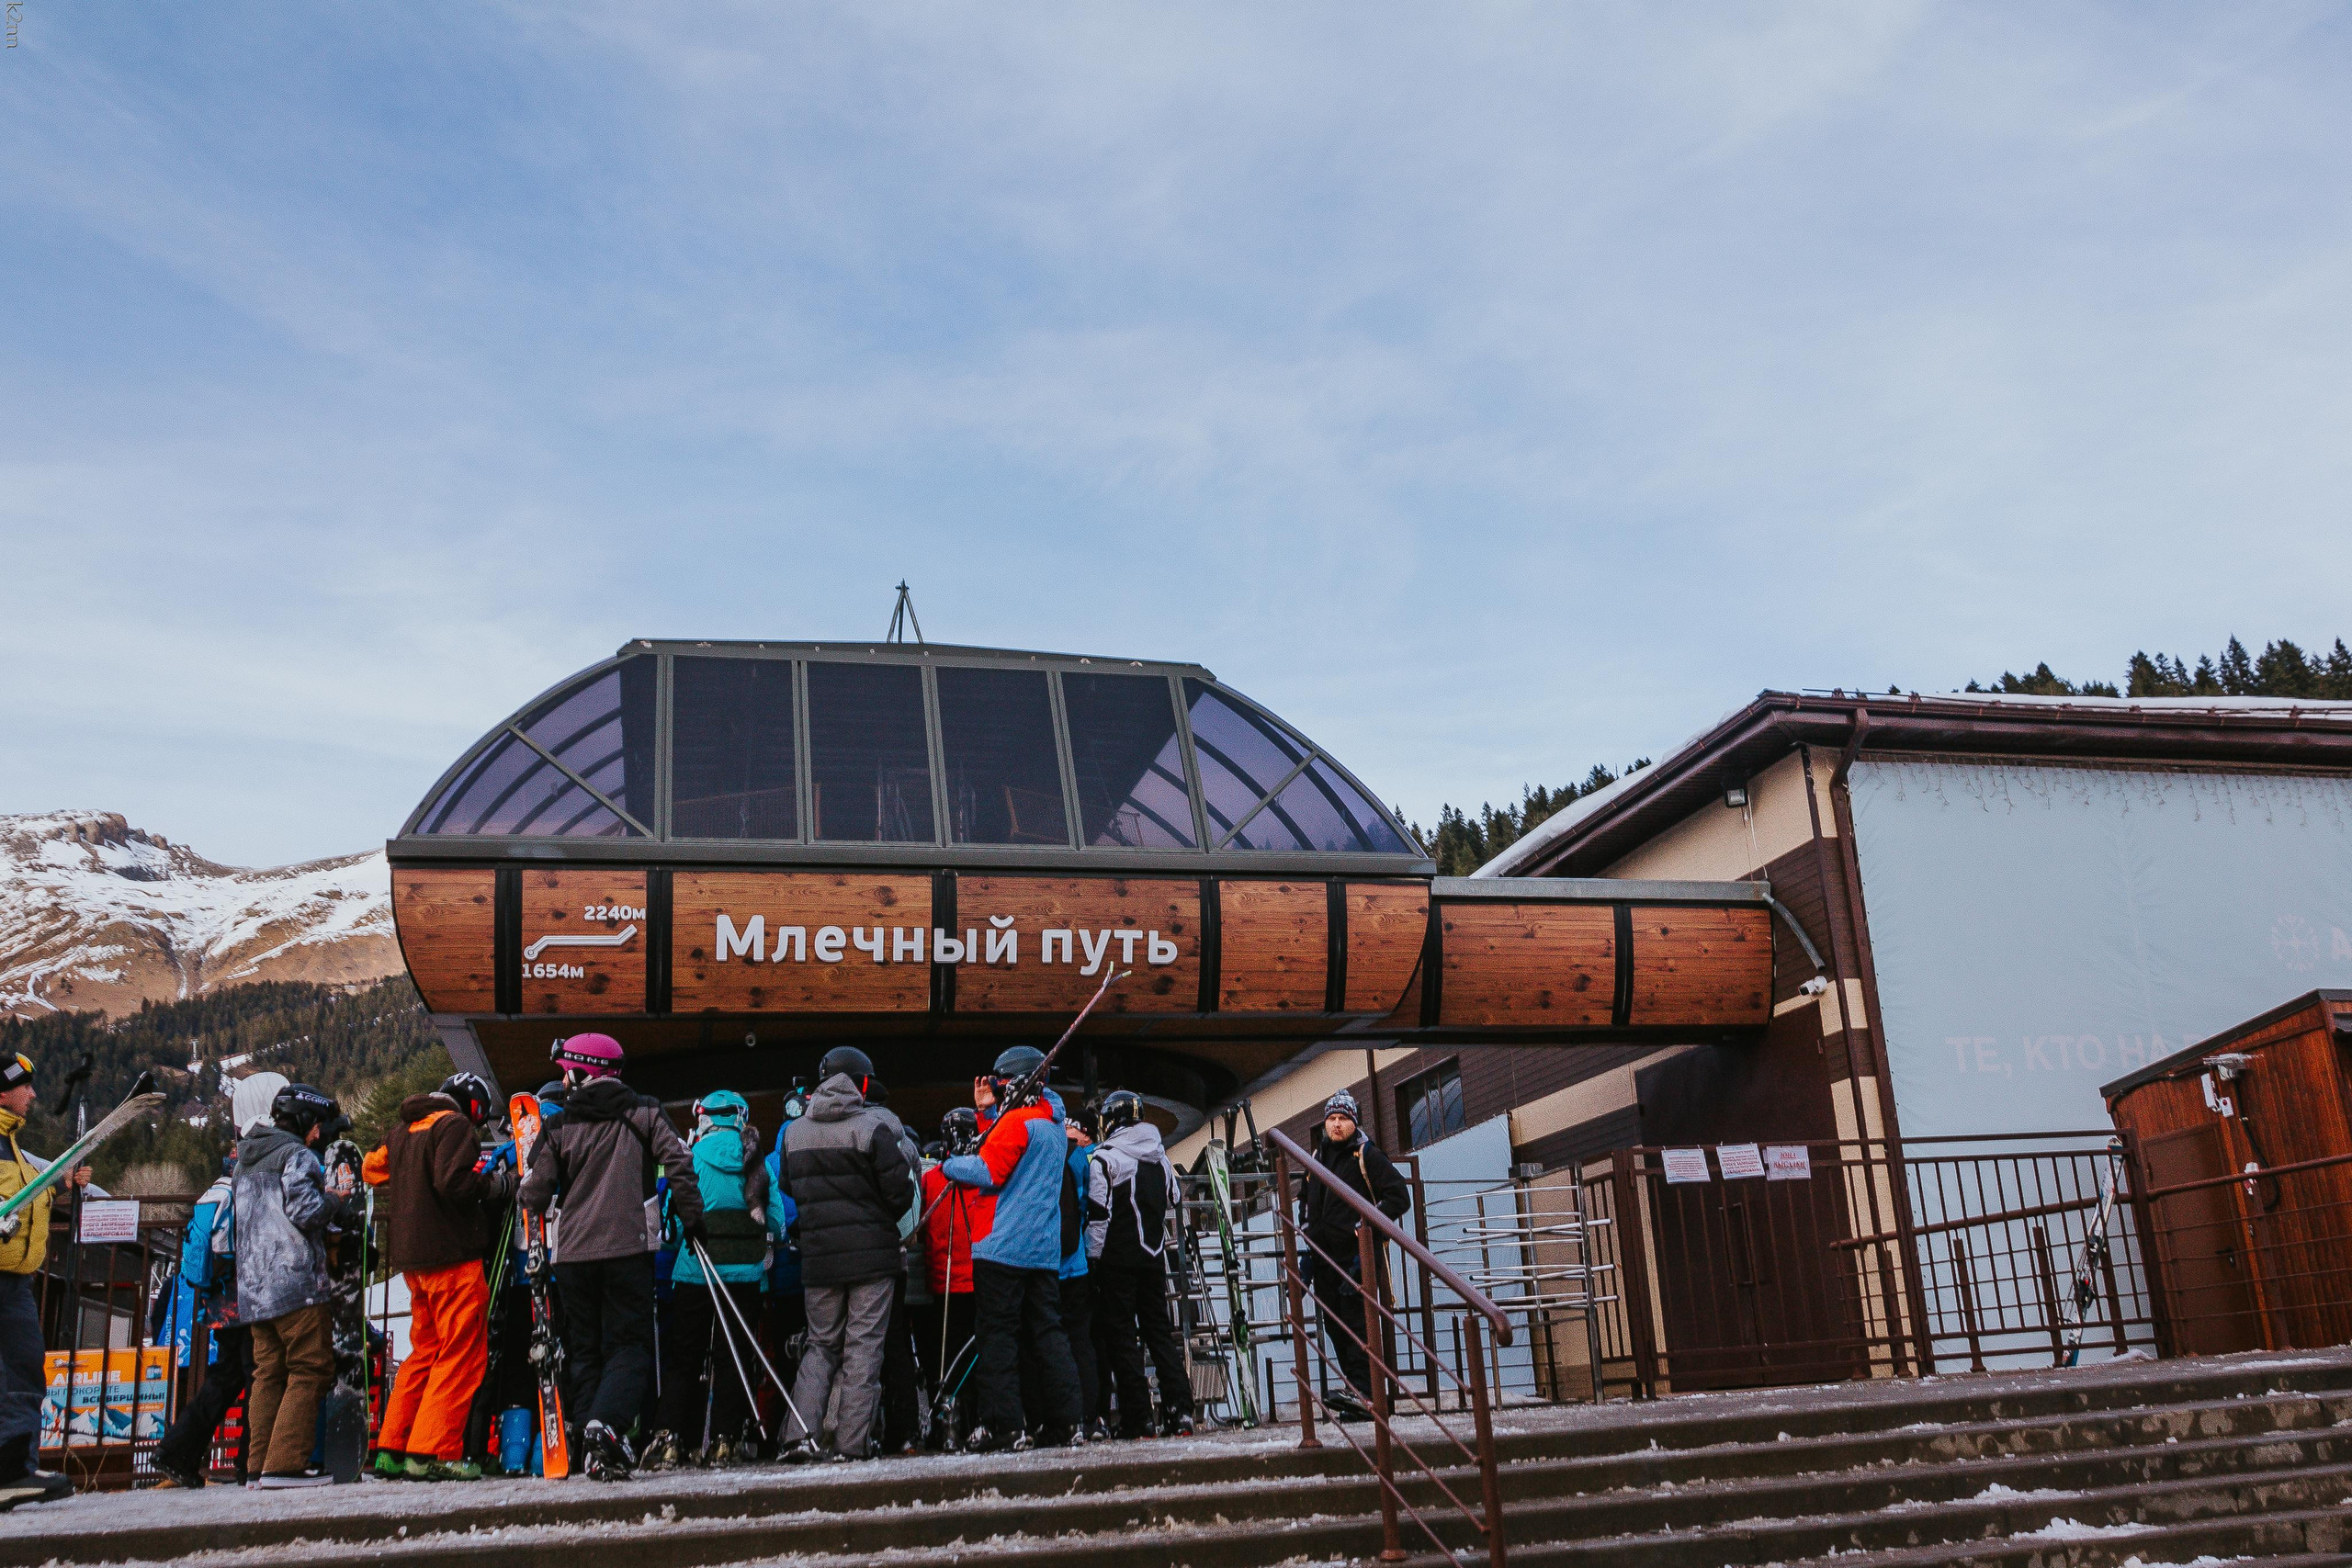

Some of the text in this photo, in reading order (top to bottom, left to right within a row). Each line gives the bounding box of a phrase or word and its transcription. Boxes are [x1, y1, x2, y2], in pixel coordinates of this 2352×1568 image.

[716, 914, 1178, 976] Млечный путь
[2023, 1033, 2108, 1072] КТО
